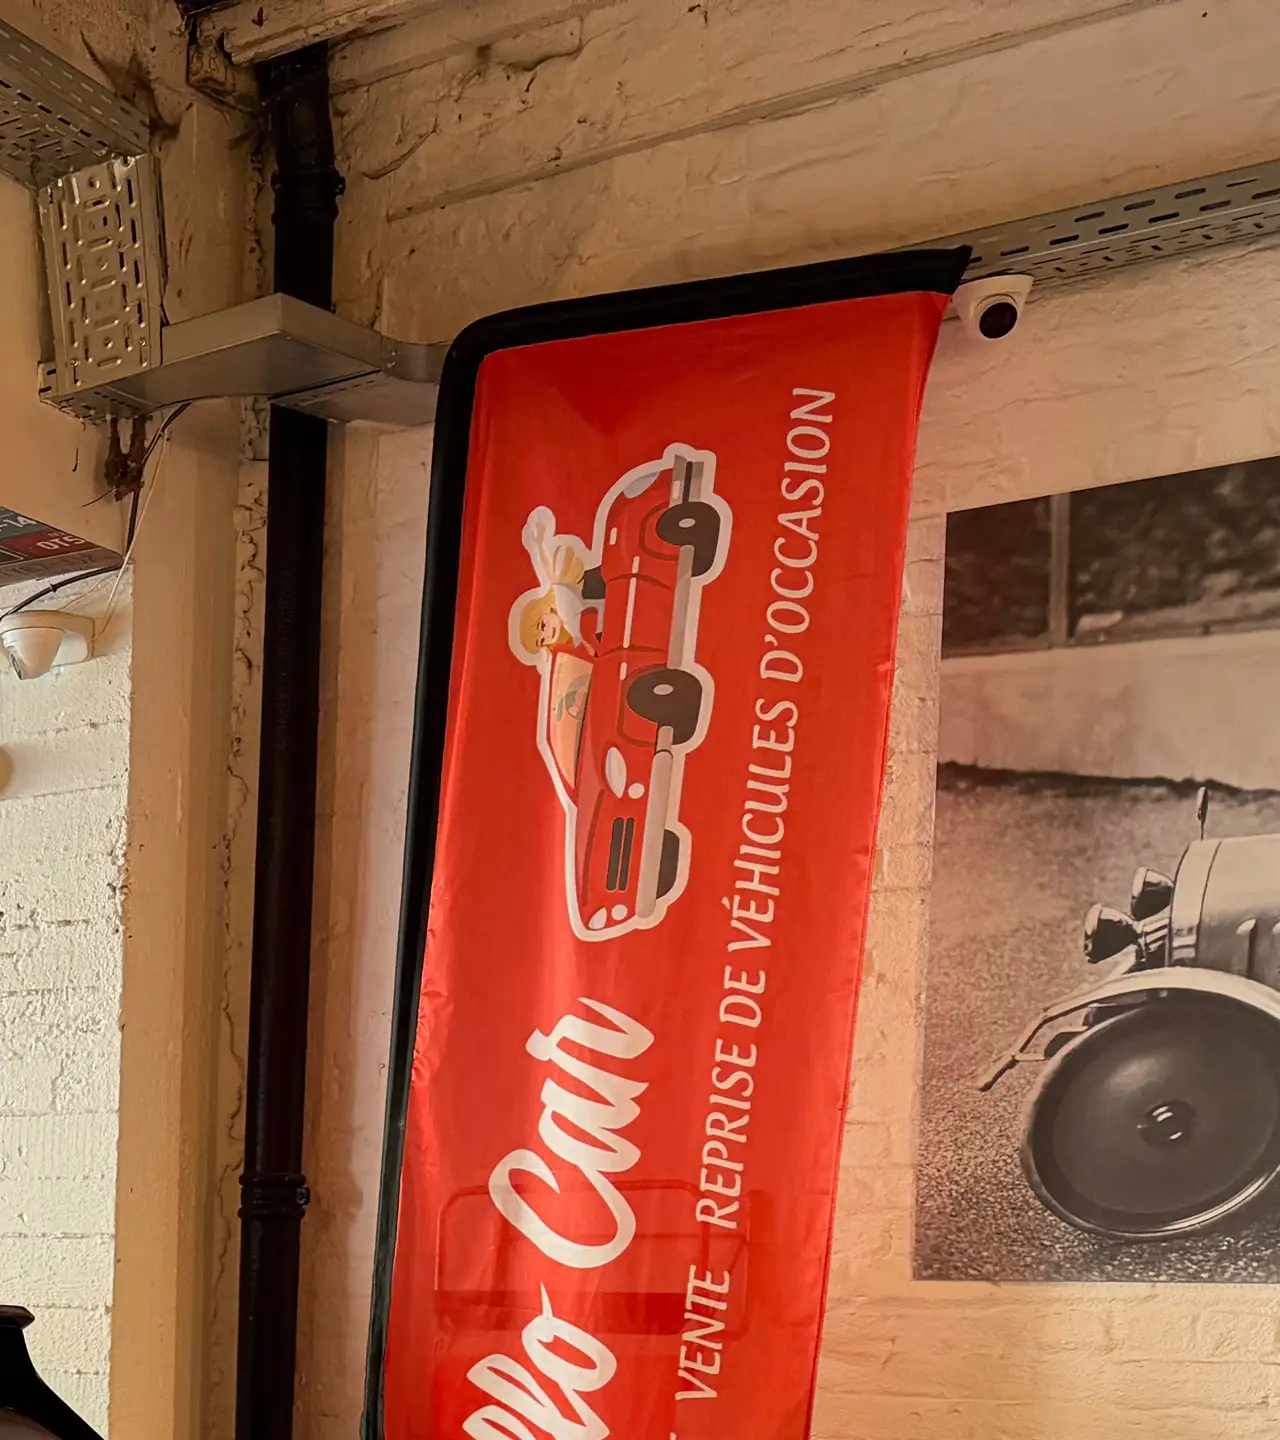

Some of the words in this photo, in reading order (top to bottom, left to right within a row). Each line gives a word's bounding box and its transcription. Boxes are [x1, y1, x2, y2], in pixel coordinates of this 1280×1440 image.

[760, 387, 835, 683] D'OCCASION
[718, 698, 798, 952] VÉHICULES
[721, 968, 765, 1029] DE
[487, 997, 655, 1268] Car
[698, 1038, 756, 1229] REPRISE
[678, 1265, 732, 1401] VENTE
